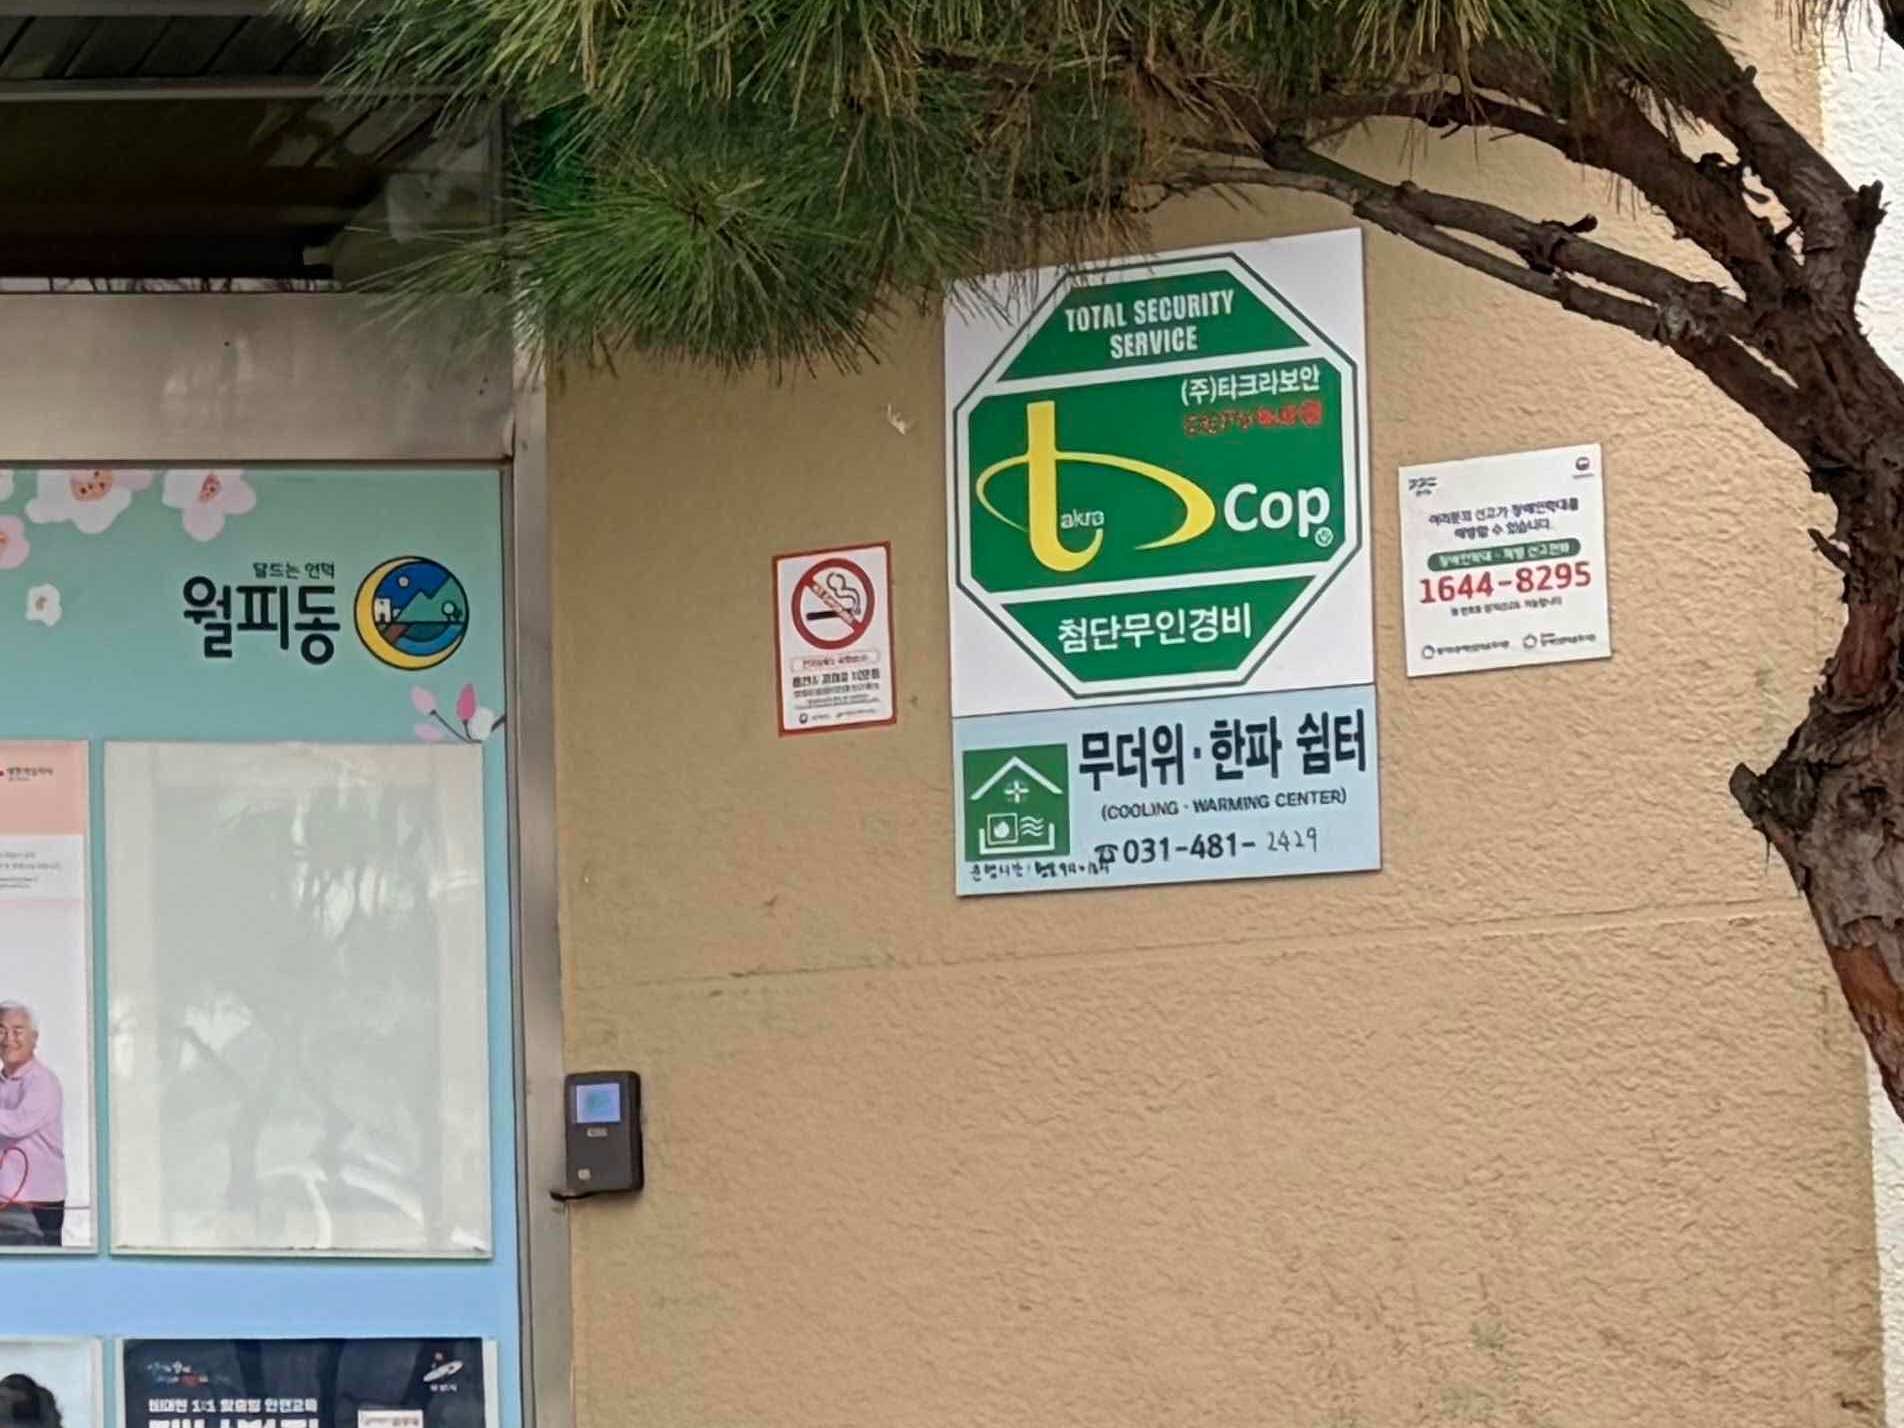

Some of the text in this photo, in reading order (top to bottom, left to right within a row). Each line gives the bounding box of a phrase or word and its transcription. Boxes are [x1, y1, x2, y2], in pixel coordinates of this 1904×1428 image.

[1065, 289, 1235, 332] TOTAL SECURITY
[1110, 326, 1198, 359] SERVICE
[1223, 483, 1330, 538] Cop
[1419, 562, 1592, 603] 1644-8295
[183, 576, 341, 665] 월피동
[1058, 602, 1253, 654] 첨단무인경비
[1297, 709, 1366, 774] 쉼터
[1193, 794, 1270, 813] WARMING
[1275, 787, 1347, 808] CENTER)
